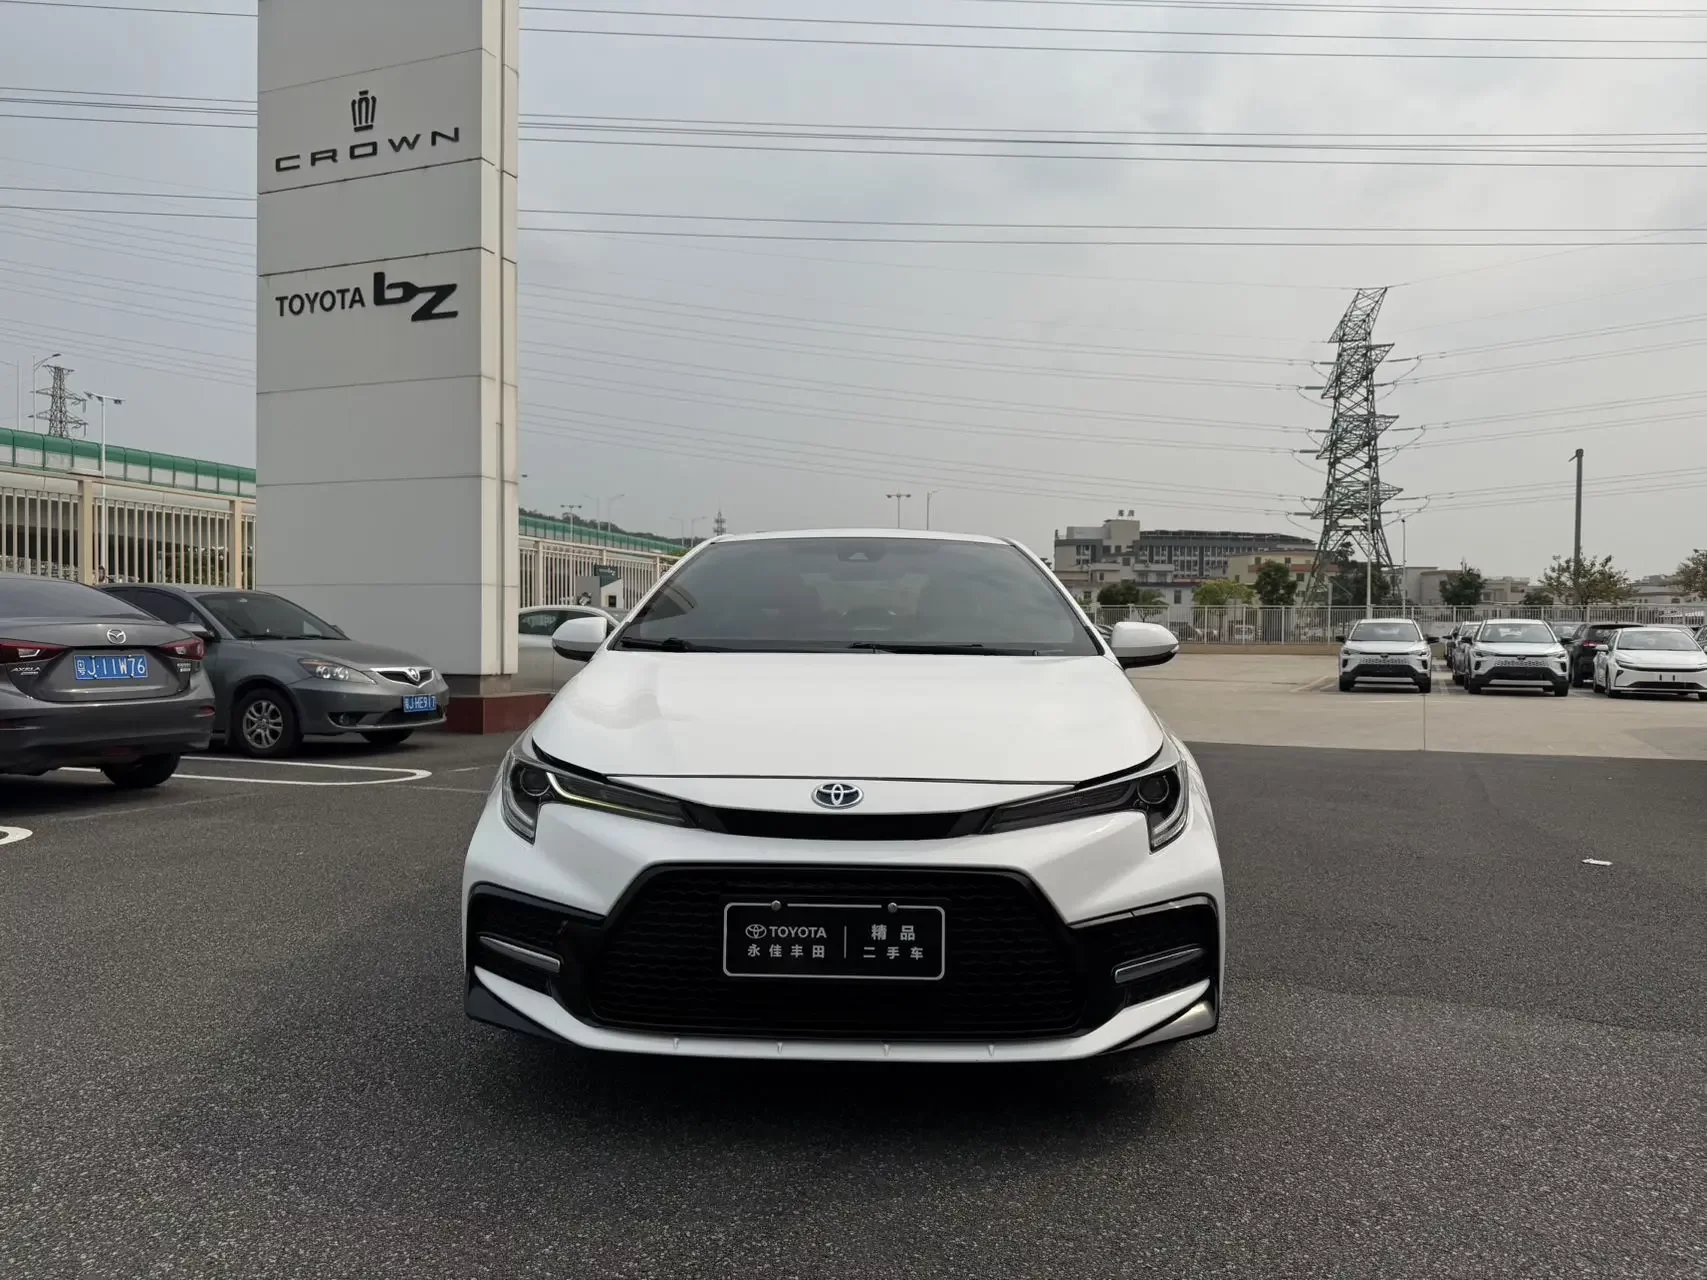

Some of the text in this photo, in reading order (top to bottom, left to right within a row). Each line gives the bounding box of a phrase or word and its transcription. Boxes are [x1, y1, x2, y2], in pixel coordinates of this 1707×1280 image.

[275, 127, 460, 172] CROWN
[275, 286, 366, 317] TOYOTA
[769, 926, 827, 939] TOYOTA
[871, 924, 916, 941] 精品
[747, 944, 825, 959] 永佳丰田
[863, 946, 924, 960] 二手车
